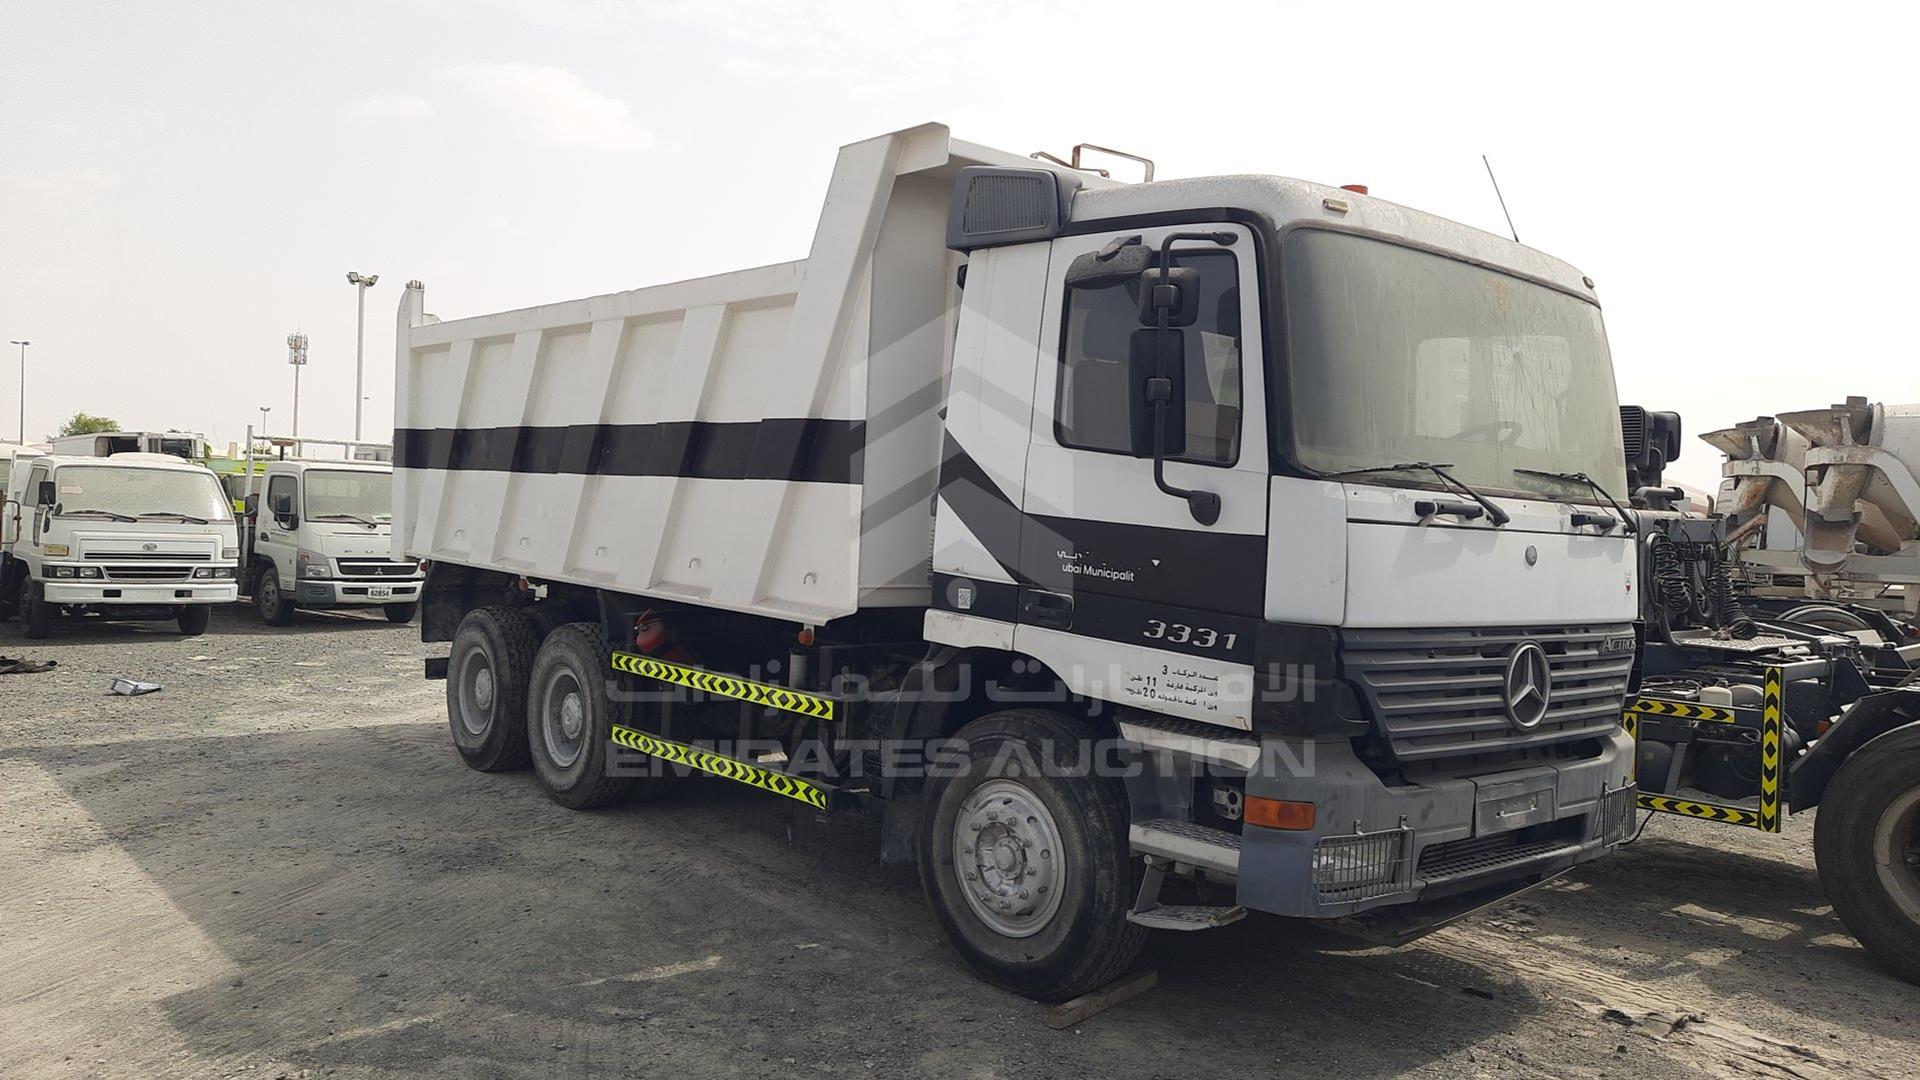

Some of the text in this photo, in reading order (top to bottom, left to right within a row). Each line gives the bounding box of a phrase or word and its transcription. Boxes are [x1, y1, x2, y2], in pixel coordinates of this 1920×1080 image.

[1062, 563, 1134, 581] ubai Municipalit
[1143, 619, 1237, 650] 3331
[1161, 665, 1168, 675] 3
[1146, 675, 1157, 687] 11
[1143, 687, 1156, 699] 20
